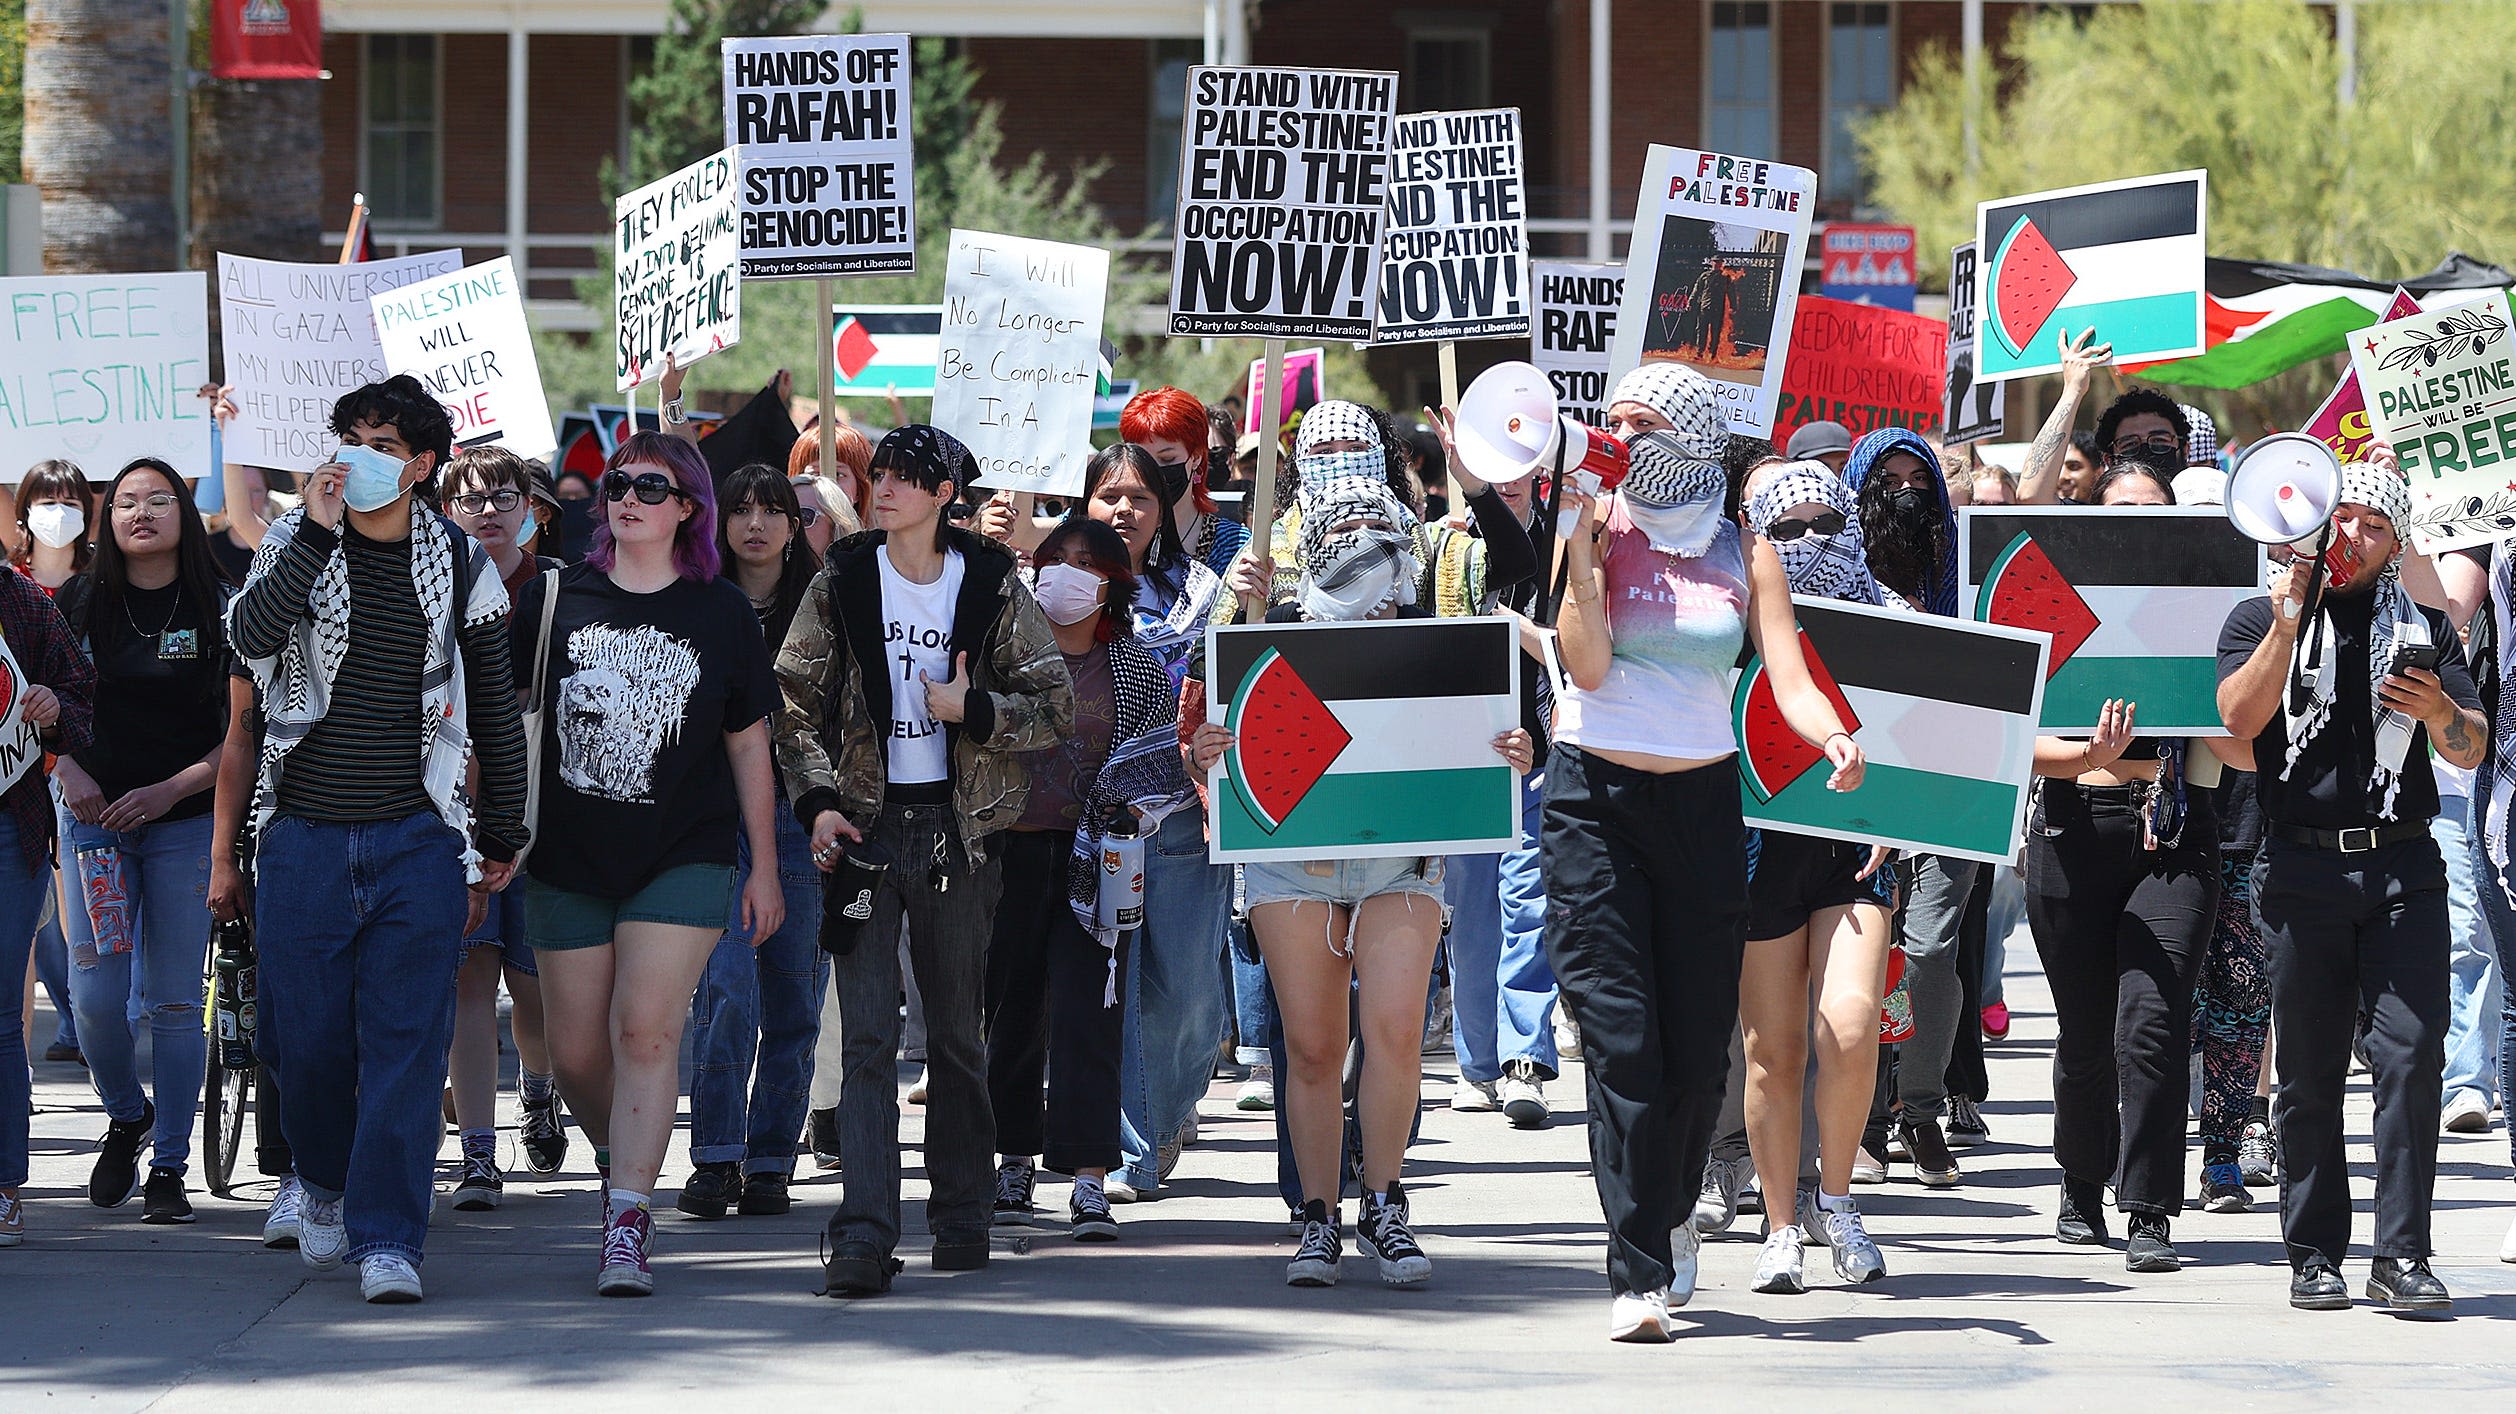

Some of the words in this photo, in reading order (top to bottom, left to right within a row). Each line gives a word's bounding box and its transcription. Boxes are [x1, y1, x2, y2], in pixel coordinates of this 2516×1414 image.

[735, 50, 840, 87] HANDS
[847, 48, 899, 84] OFF
[1196, 71, 1300, 107] STAND
[1310, 74, 1391, 112] WITH
[736, 88, 898, 144] RAFAH!
[1194, 109, 1388, 151] PALESTINE!
[1445, 114, 1514, 145] WITH
[745, 165, 830, 206] STOP
[835, 162, 896, 202] THE
[1191, 149, 1287, 200] END
[1301, 152, 1387, 206] THE
[1390, 145, 1517, 183] LESTINE!
[1697, 153, 1769, 185] FREE
[619, 191, 664, 253] THEY
[670, 157, 728, 222] FOOLED
[1386, 184, 1436, 228] ND
[1446, 178, 1521, 224] THE
[1668, 176, 1800, 213] PALESTINE
[741, 206, 907, 250] GENOCIDE!
[1184, 205, 1378, 245] OCCUPATION
[1383, 226, 1520, 262] CUPATION
[225, 261, 274, 301] ALL
[753, 263, 780, 274] Party
[781, 262, 795, 271] for
[796, 261, 842, 271] Socialism
[843, 260, 862, 270] and
[863, 258, 911, 269] Liberation
[1026, 253, 1075, 288] Will
[1179, 239, 1370, 318] NOW!
[381, 269, 508, 331] PALESTINE
[619, 269, 676, 325] GENOCIDE
[660, 263, 735, 353] DEFENCE
[1380, 254, 1521, 324] NOW!
[1542, 274, 1626, 307] HANDS
[12, 287, 161, 341] FREE
[234, 307, 259, 337] IN
[272, 312, 354, 344] GAZA
[949, 296, 978, 326] No
[998, 297, 1085, 344] Longer
[1194, 321, 1222, 331] Party
[1224, 322, 1239, 331] for
[1240, 321, 1292, 332] Socialism
[1293, 323, 1313, 333] and
[1315, 324, 1369, 336] Liberation
[1377, 330, 1402, 341] Party
[1403, 329, 1416, 338] for
[1418, 325, 1462, 337] Socialism
[1463, 324, 1481, 334] and
[1482, 322, 1528, 333] Liberation
[1542, 308, 1617, 353] RAF
[420, 321, 473, 352] WILL
[1881, 321, 1921, 365] FOR
[238, 352, 268, 384] MY
[280, 359, 388, 388] UNIVERS
[424, 350, 503, 395] NEVER
[940, 348, 982, 380] Be
[991, 350, 1090, 392] Complicit
[1788, 355, 1902, 404] CHILDREN
[1908, 373, 1937, 405] OF
[2378, 358, 2516, 421] PALESTINE
[0, 361, 200, 429] ALESTINE
[1715, 383, 1755, 403] RON
[977, 396, 1010, 427] In
[1021, 402, 1039, 432] A
[2422, 410, 2460, 428] WILL
[2462, 402, 2485, 418] BE
[978, 452, 1068, 479] nocide"
[2392, 411, 2516, 486] FREE
[908, 625, 952, 653] LOV
